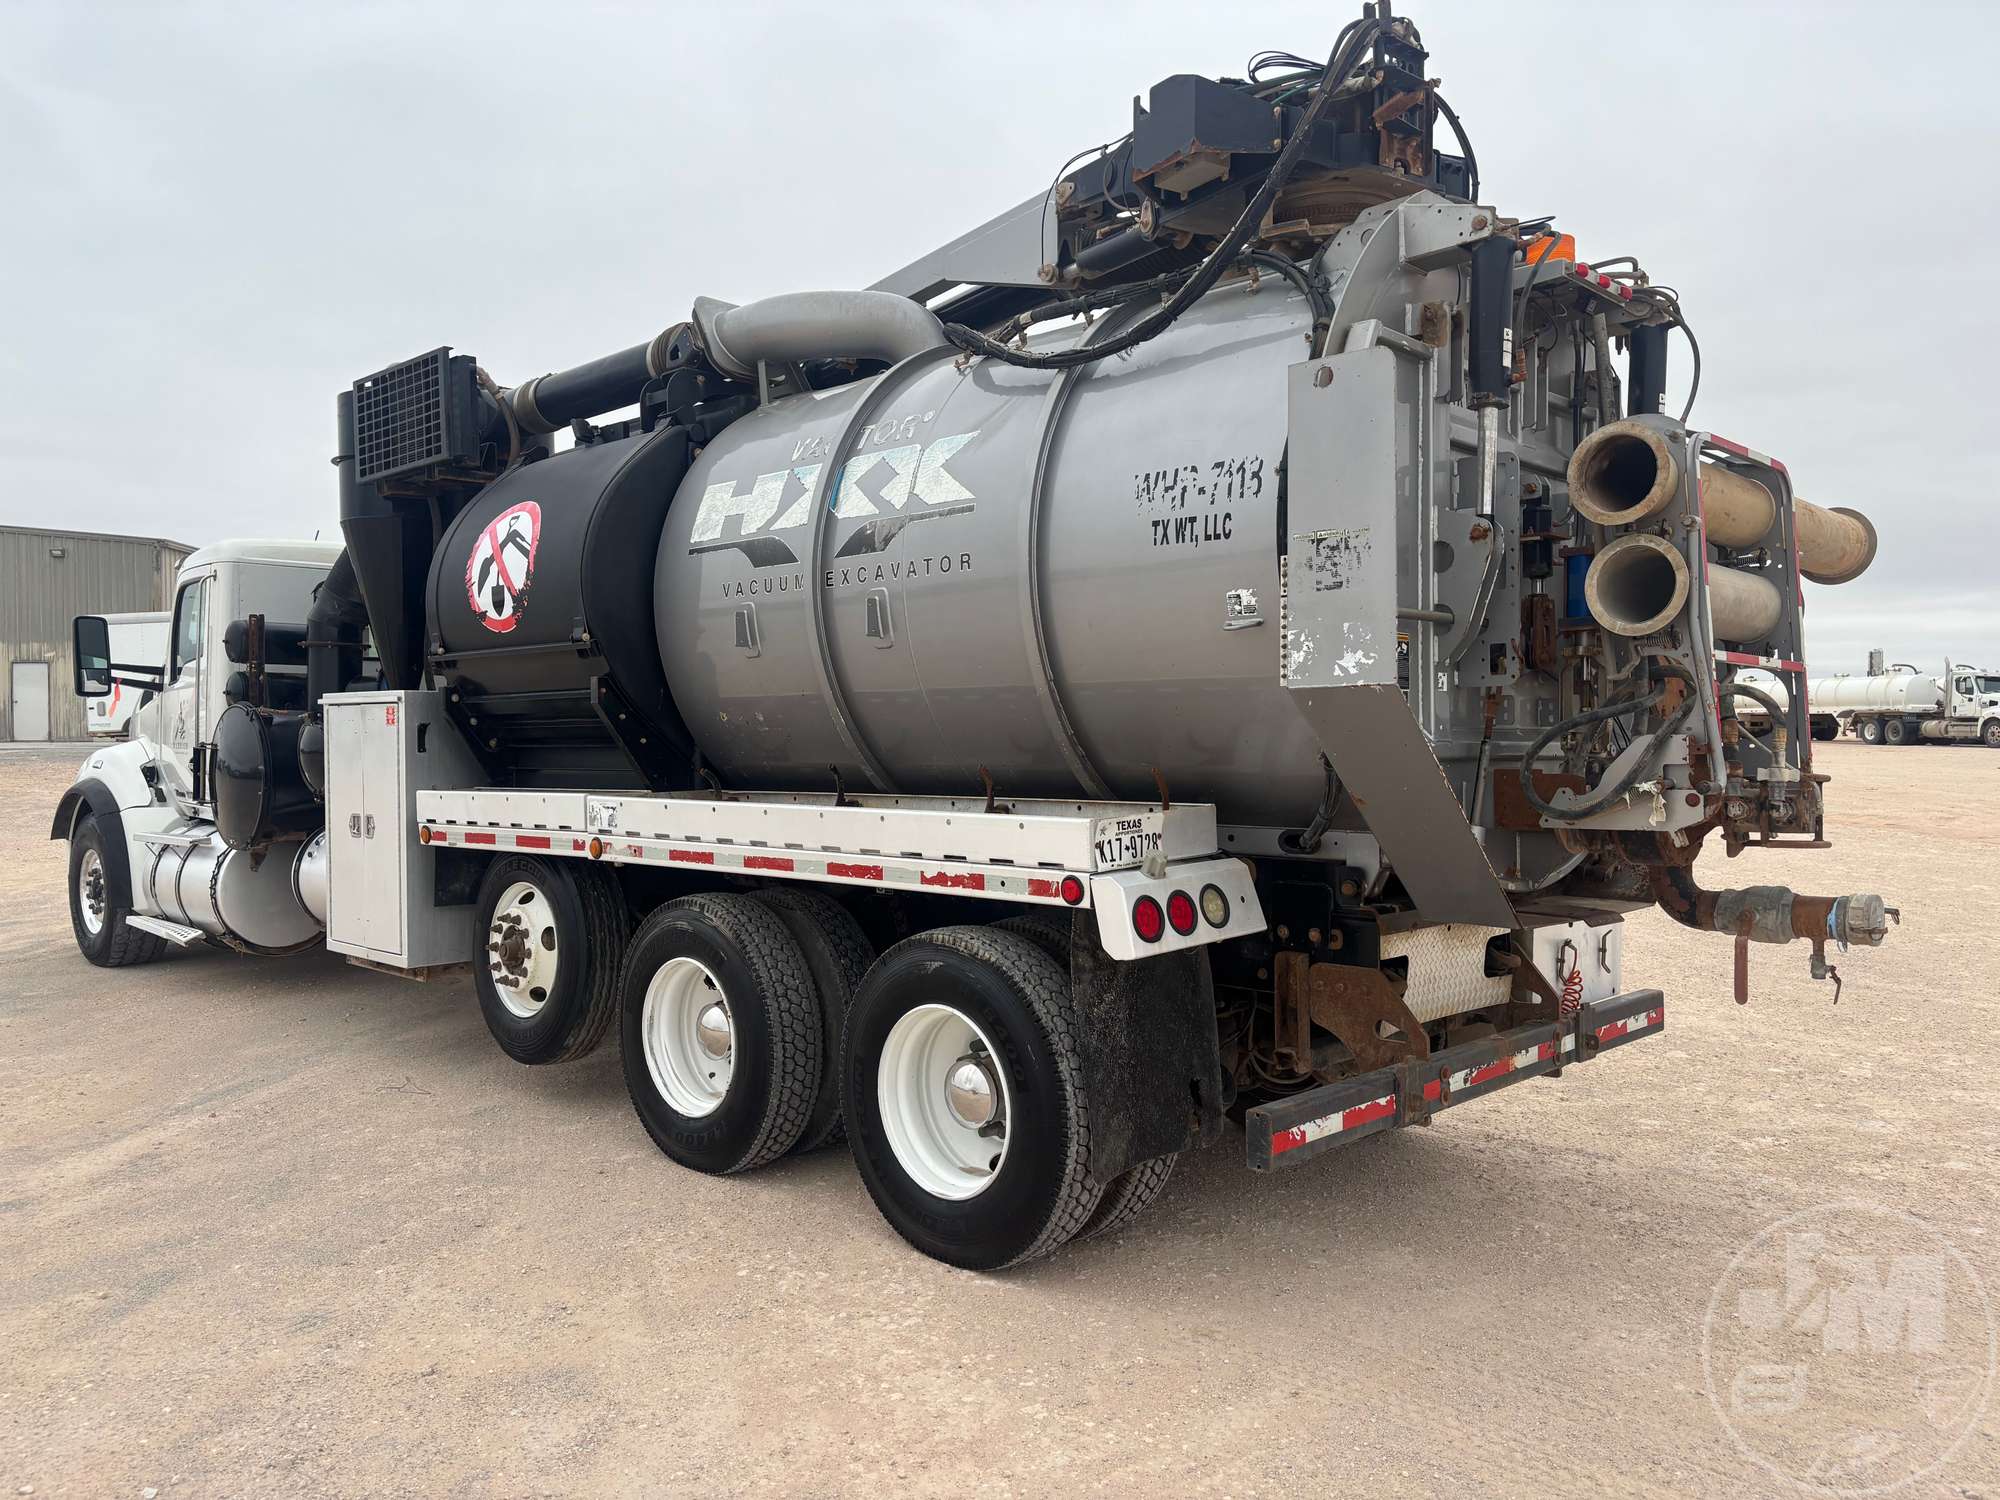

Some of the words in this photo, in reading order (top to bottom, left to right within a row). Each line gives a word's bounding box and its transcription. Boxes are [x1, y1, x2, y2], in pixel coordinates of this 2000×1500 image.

[1151, 518, 1171, 546] TX
[1204, 512, 1232, 541] LLC
[722, 573, 804, 598] VACUUM
[825, 552, 972, 588] EXCAVATOR
[1116, 818, 1142, 831] TEXAS
